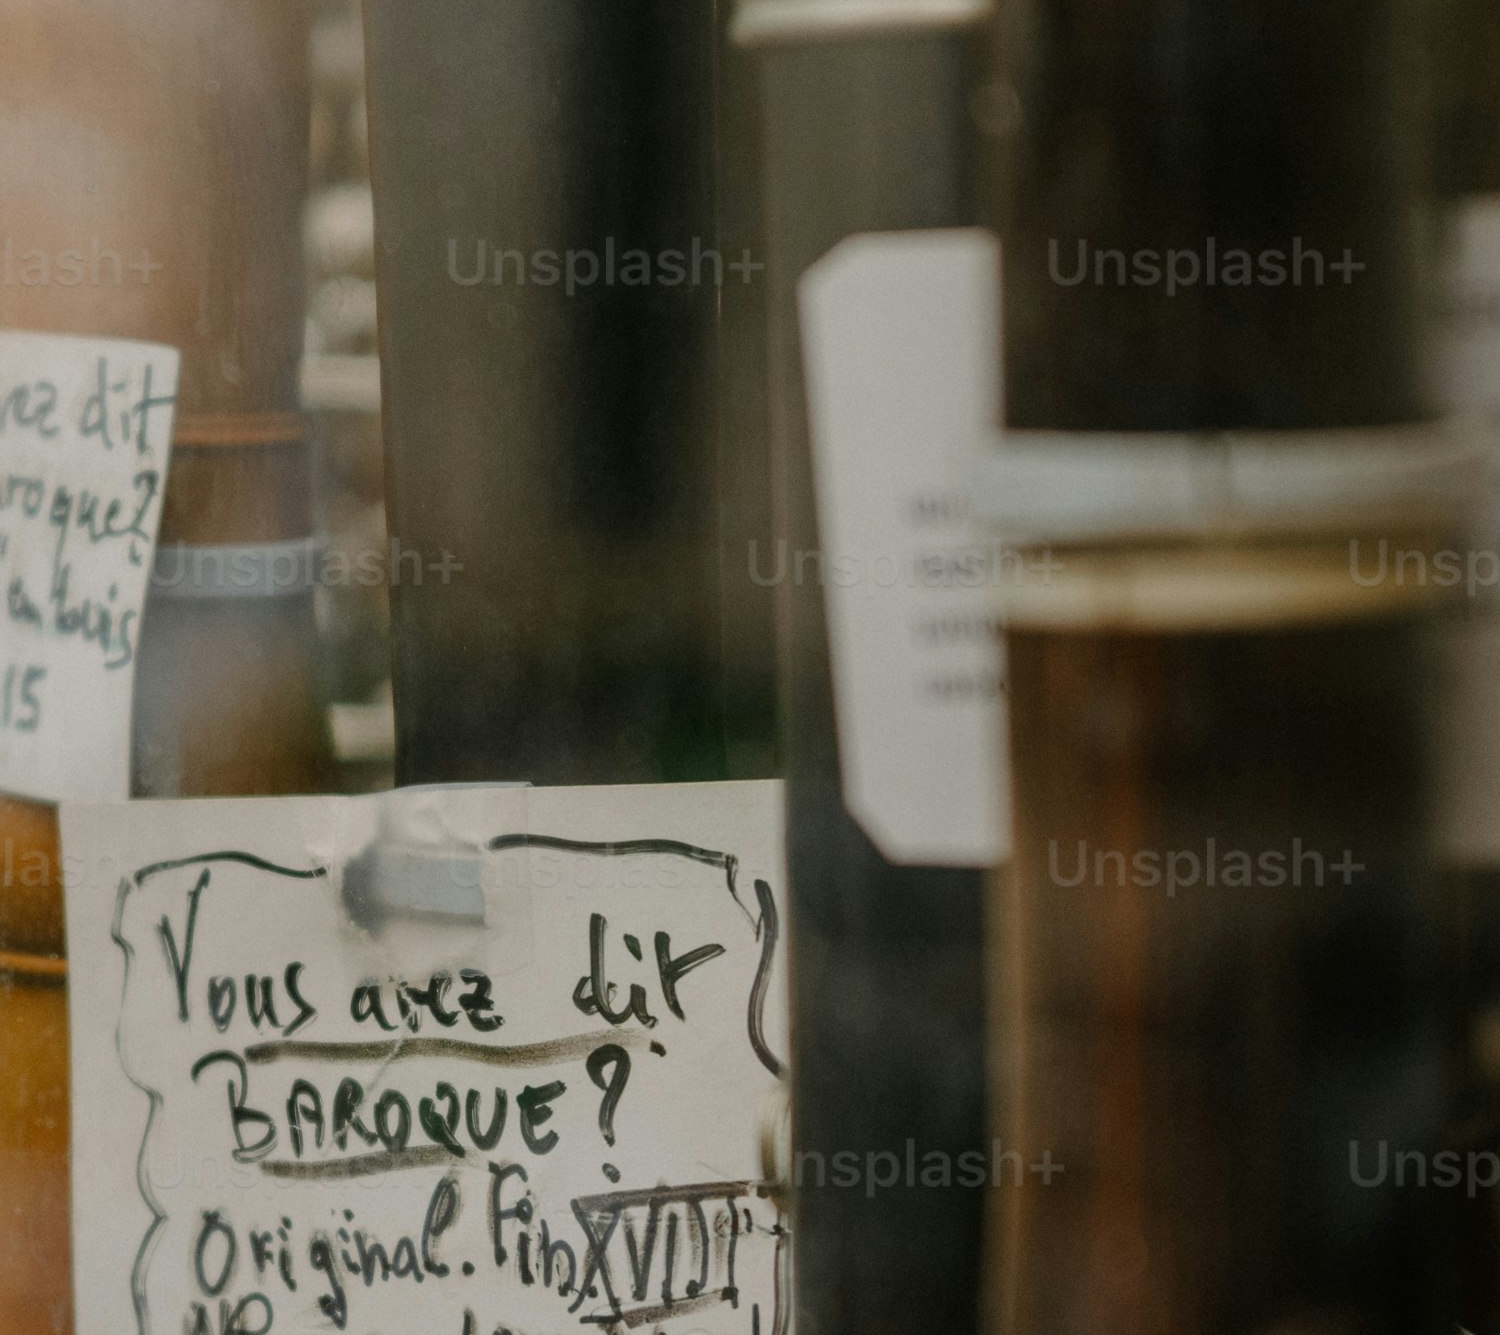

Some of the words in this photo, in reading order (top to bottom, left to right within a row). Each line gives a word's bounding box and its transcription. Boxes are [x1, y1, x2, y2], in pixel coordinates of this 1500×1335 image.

[80, 357, 175, 454] dit
[157, 867, 318, 1037] Vous
[350, 967, 505, 1033] avez
[572, 913, 727, 1030] dit
